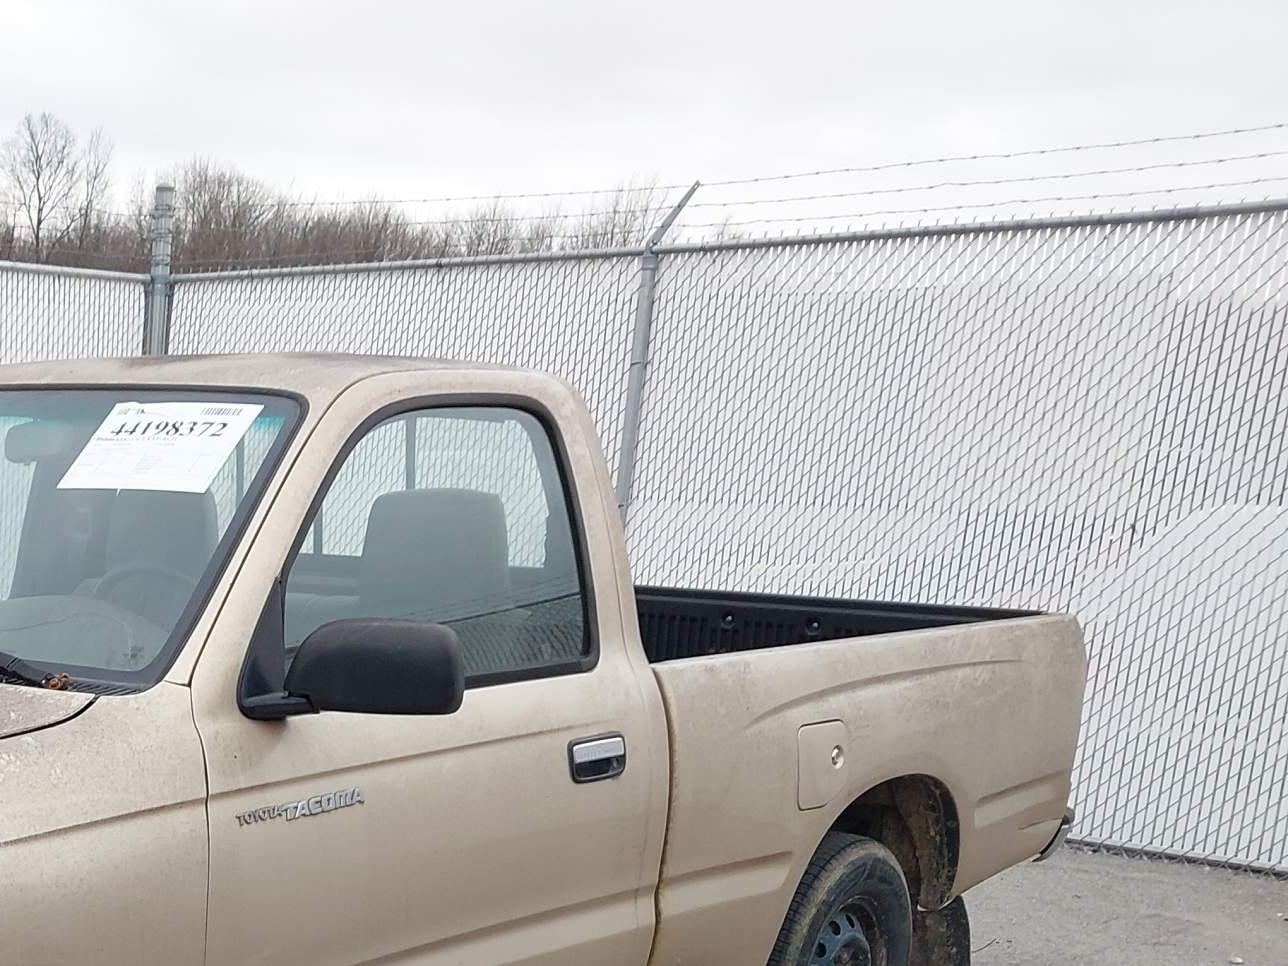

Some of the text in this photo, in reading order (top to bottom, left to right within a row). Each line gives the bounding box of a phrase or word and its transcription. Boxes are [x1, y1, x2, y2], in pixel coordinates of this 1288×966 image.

[110, 420, 229, 437] 44198372
[235, 787, 365, 828] TOYOTA TACOMA
